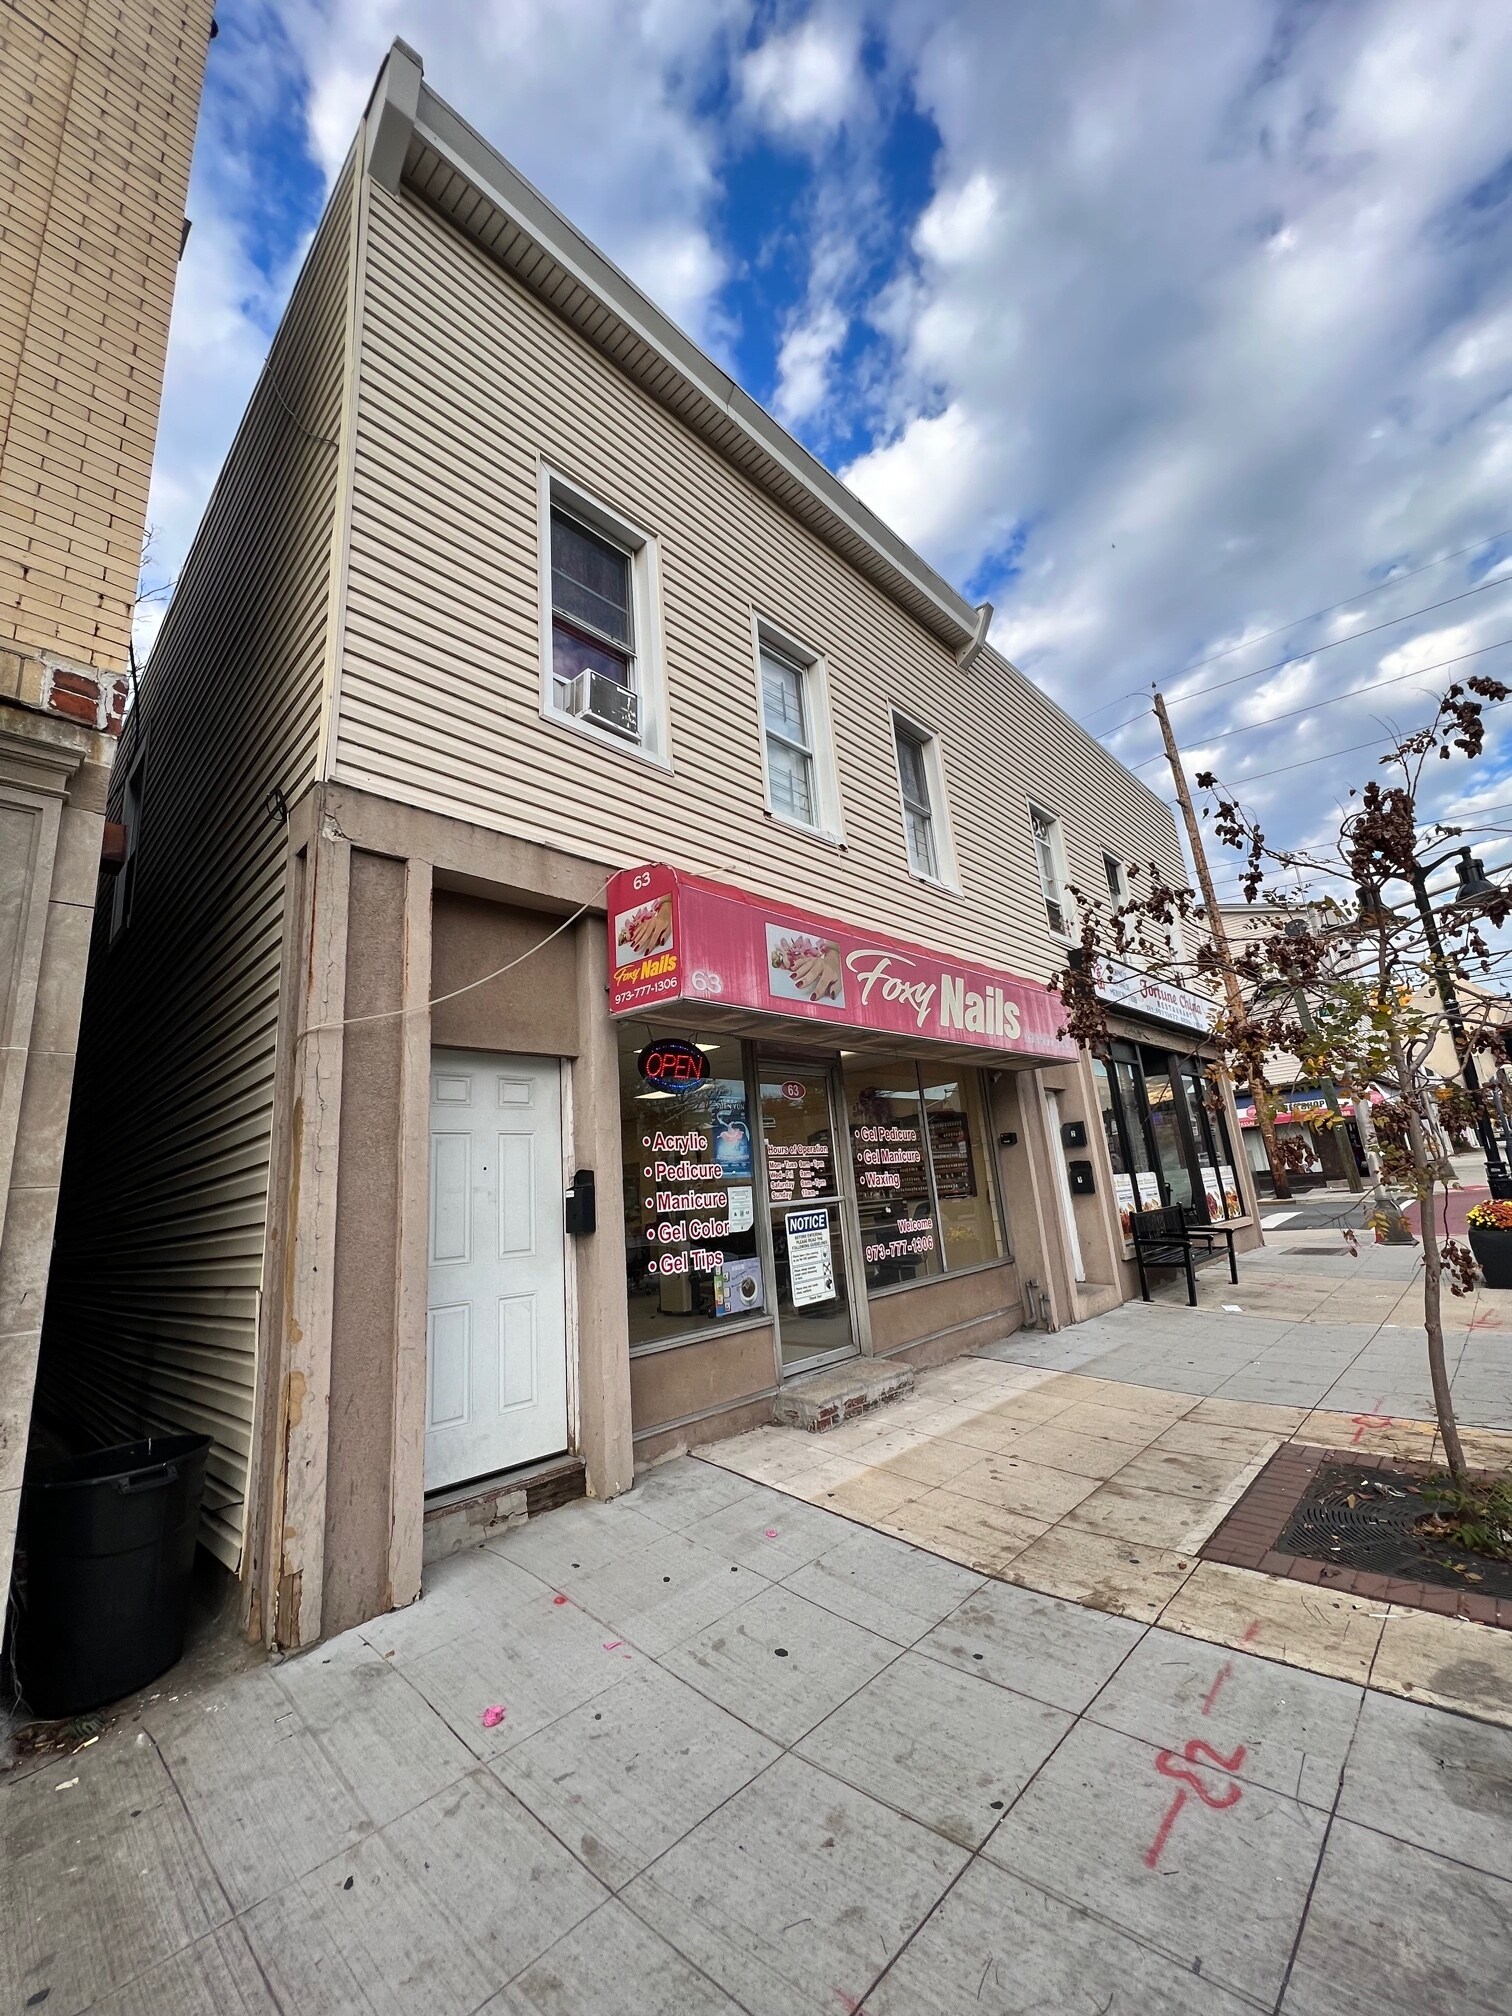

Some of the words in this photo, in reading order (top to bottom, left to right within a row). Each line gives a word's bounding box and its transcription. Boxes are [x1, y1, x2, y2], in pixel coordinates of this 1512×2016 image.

[633, 872, 651, 890] 63
[614, 964, 641, 986] Foxy
[641, 954, 677, 980] Nails
[615, 977, 678, 1004] 973-777-1306
[691, 970, 722, 994] 63
[1140, 979, 1177, 1006] Fortune
[845, 949, 937, 1028] Foxy
[940, 973, 1021, 1040] Nails
[646, 1053, 703, 1080] OPEN
[787, 1084, 799, 1096] 63
[652, 1131, 708, 1155] Acrylic
[861, 1126, 877, 1141] Gel
[877, 1127, 917, 1141] Pedicure
[768, 1145, 788, 1155] Hours
[789, 1144, 797, 1155] of
[797, 1143, 828, 1157] Operation
[863, 1149, 880, 1164] Gel
[881, 1148, 920, 1164] Manicure
[655, 1161, 723, 1181] Pedicure
[865, 1171, 900, 1189] Waxing
[770, 1180, 795, 1190] Saturday
[656, 1190, 727, 1213] Manicure
[771, 1191, 793, 1201] Sunday
[658, 1219, 686, 1243] Gel
[689, 1218, 730, 1239] Color
[790, 1214, 826, 1232] NOTICE
[897, 1217, 933, 1233] Welcome
[865, 1235, 934, 1262] 973-777-1306
[659, 1251, 688, 1275] Gel
[690, 1249, 723, 1273] Tips
